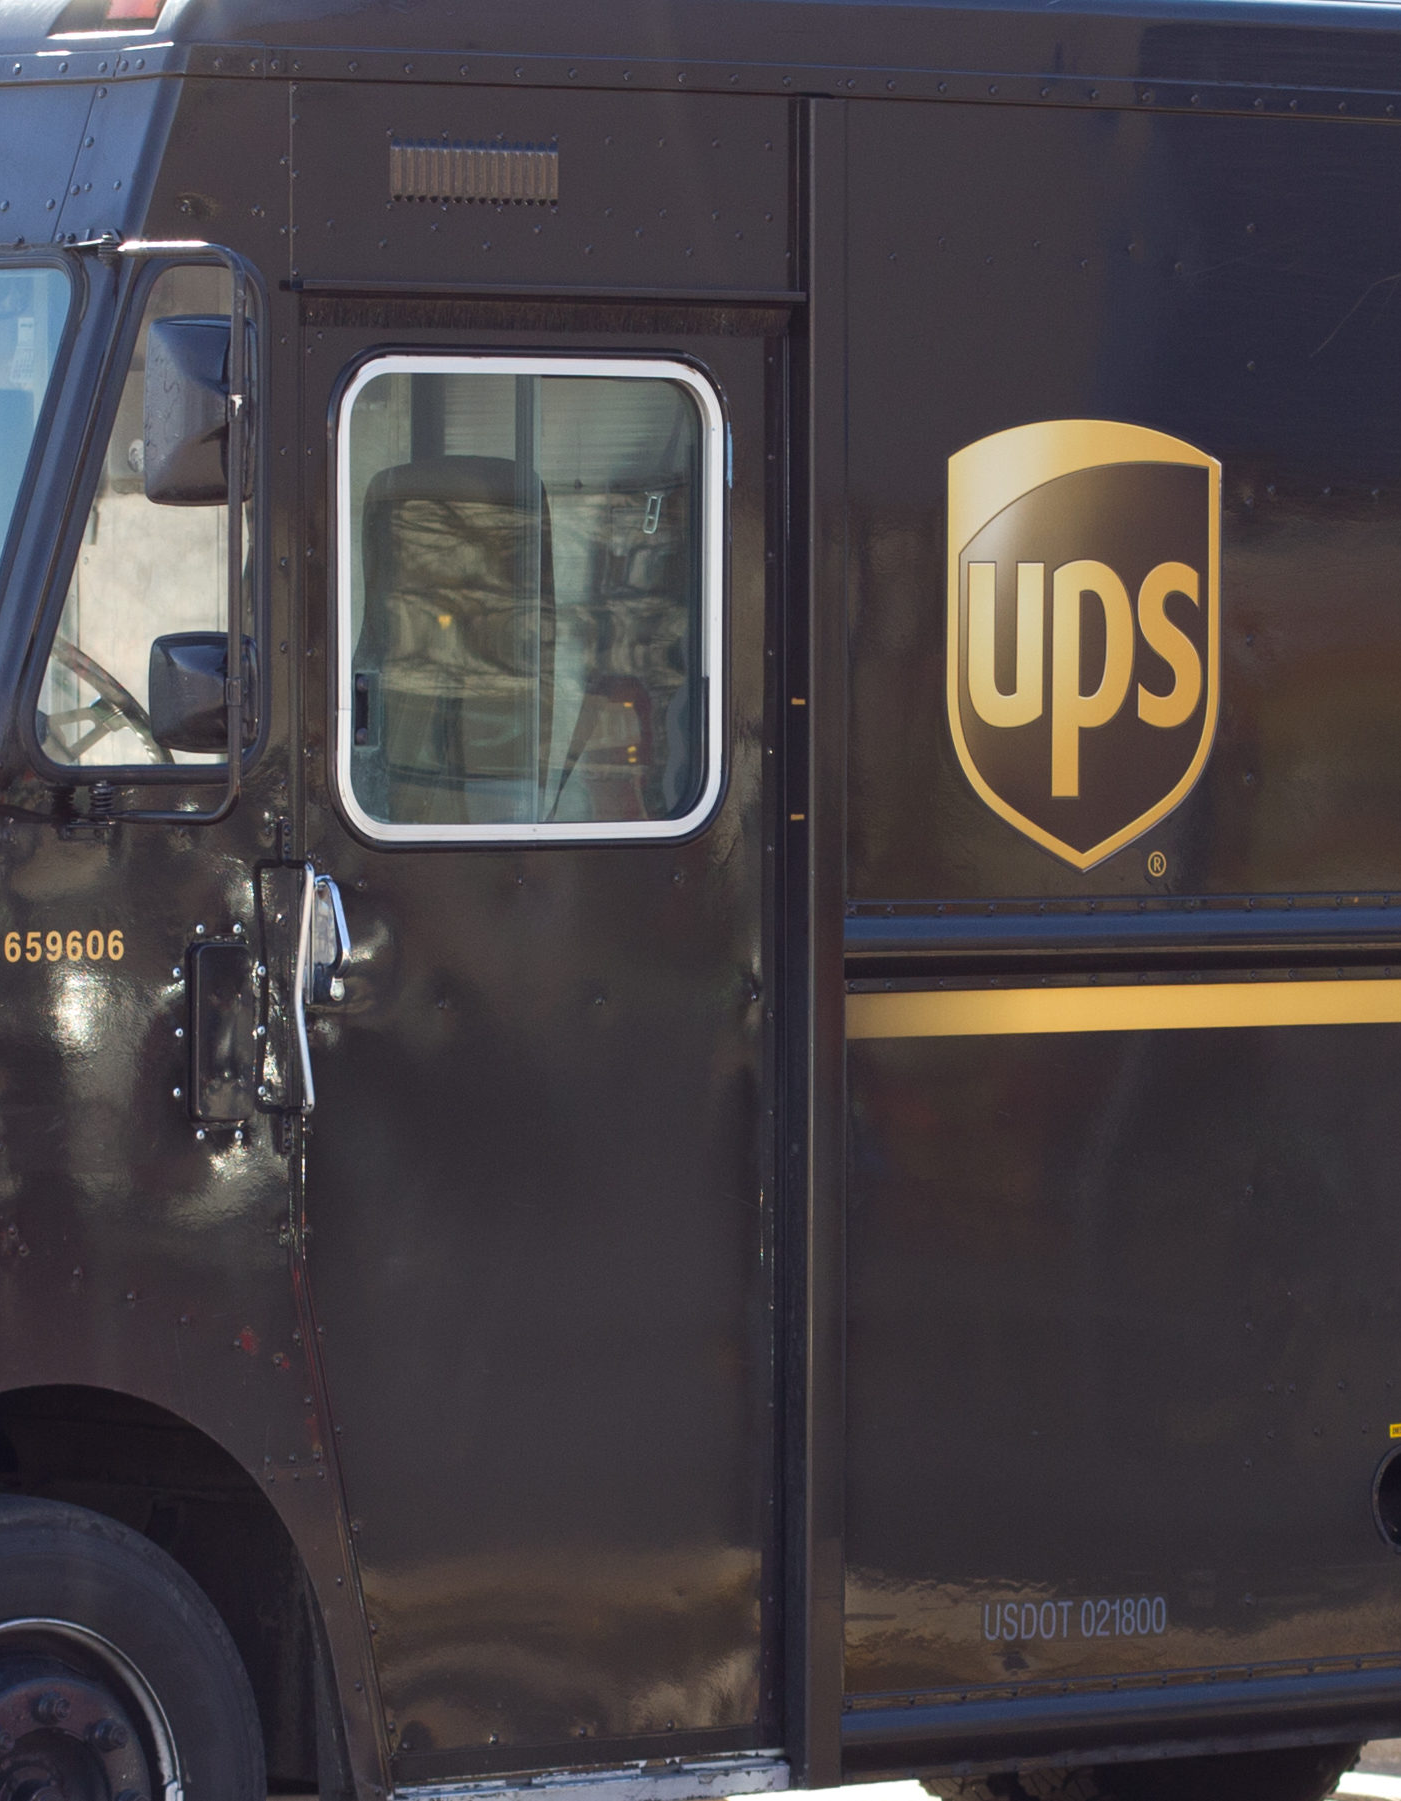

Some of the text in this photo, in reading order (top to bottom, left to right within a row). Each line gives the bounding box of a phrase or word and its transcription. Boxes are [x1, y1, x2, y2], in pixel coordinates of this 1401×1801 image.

[4, 929, 124, 963] 659606
[984, 1597, 1166, 1641] USDOT 021800
